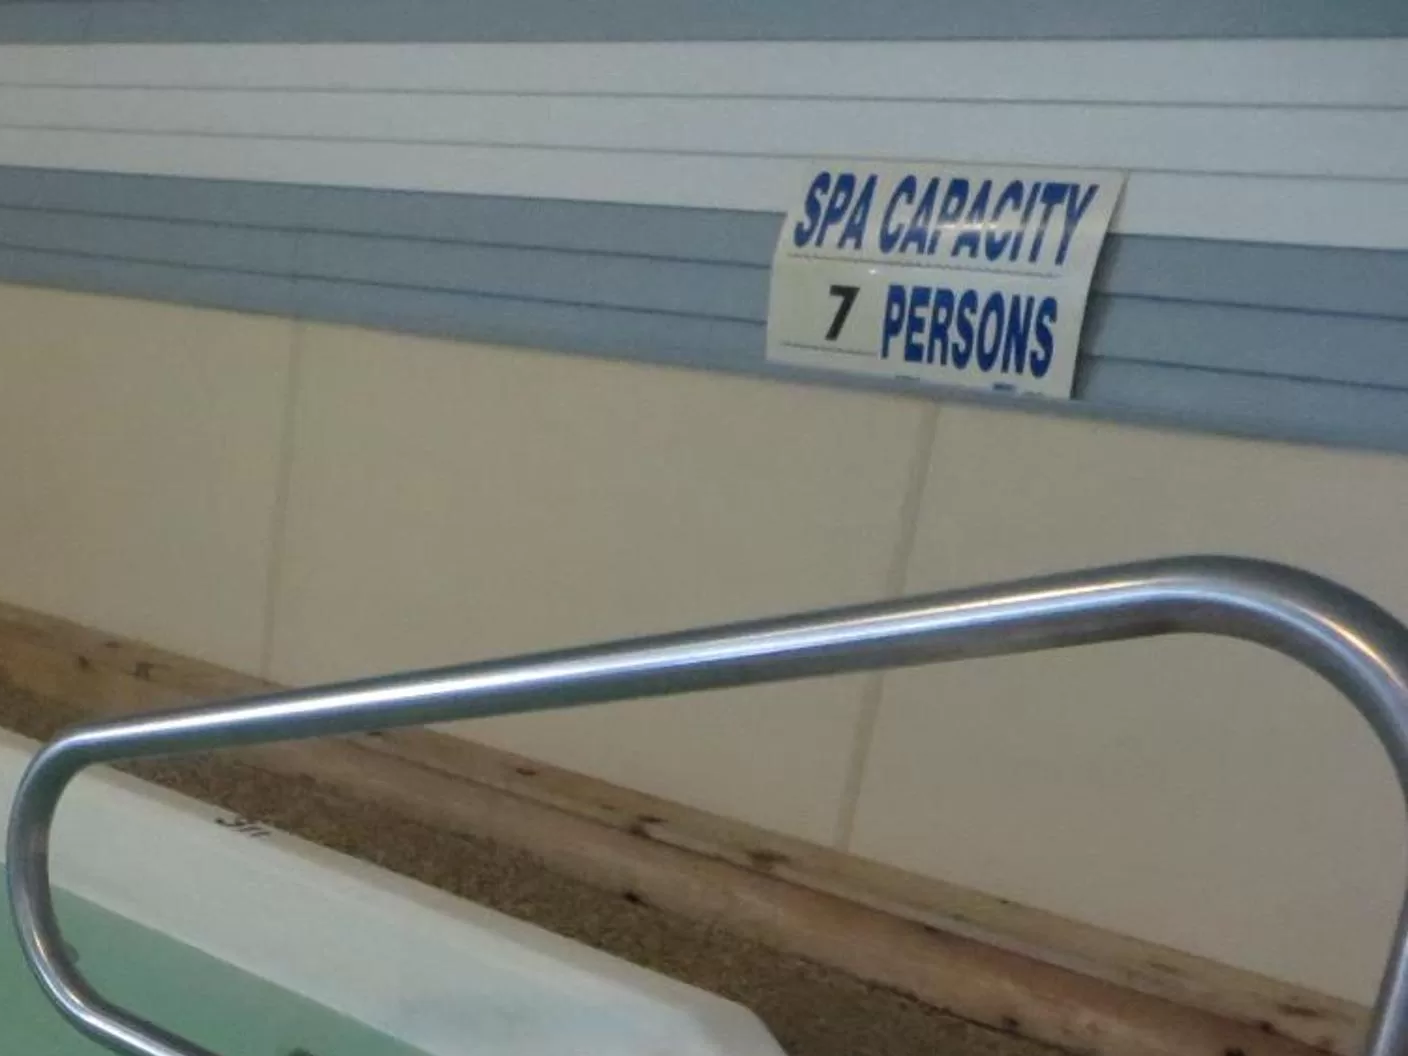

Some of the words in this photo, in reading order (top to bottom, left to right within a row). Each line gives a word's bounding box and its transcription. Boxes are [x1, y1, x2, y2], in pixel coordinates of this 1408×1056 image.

[794, 170, 878, 251] SPA
[878, 174, 1100, 266] CAPACITY
[824, 284, 861, 341] 7
[880, 283, 1058, 379] PERSONS
